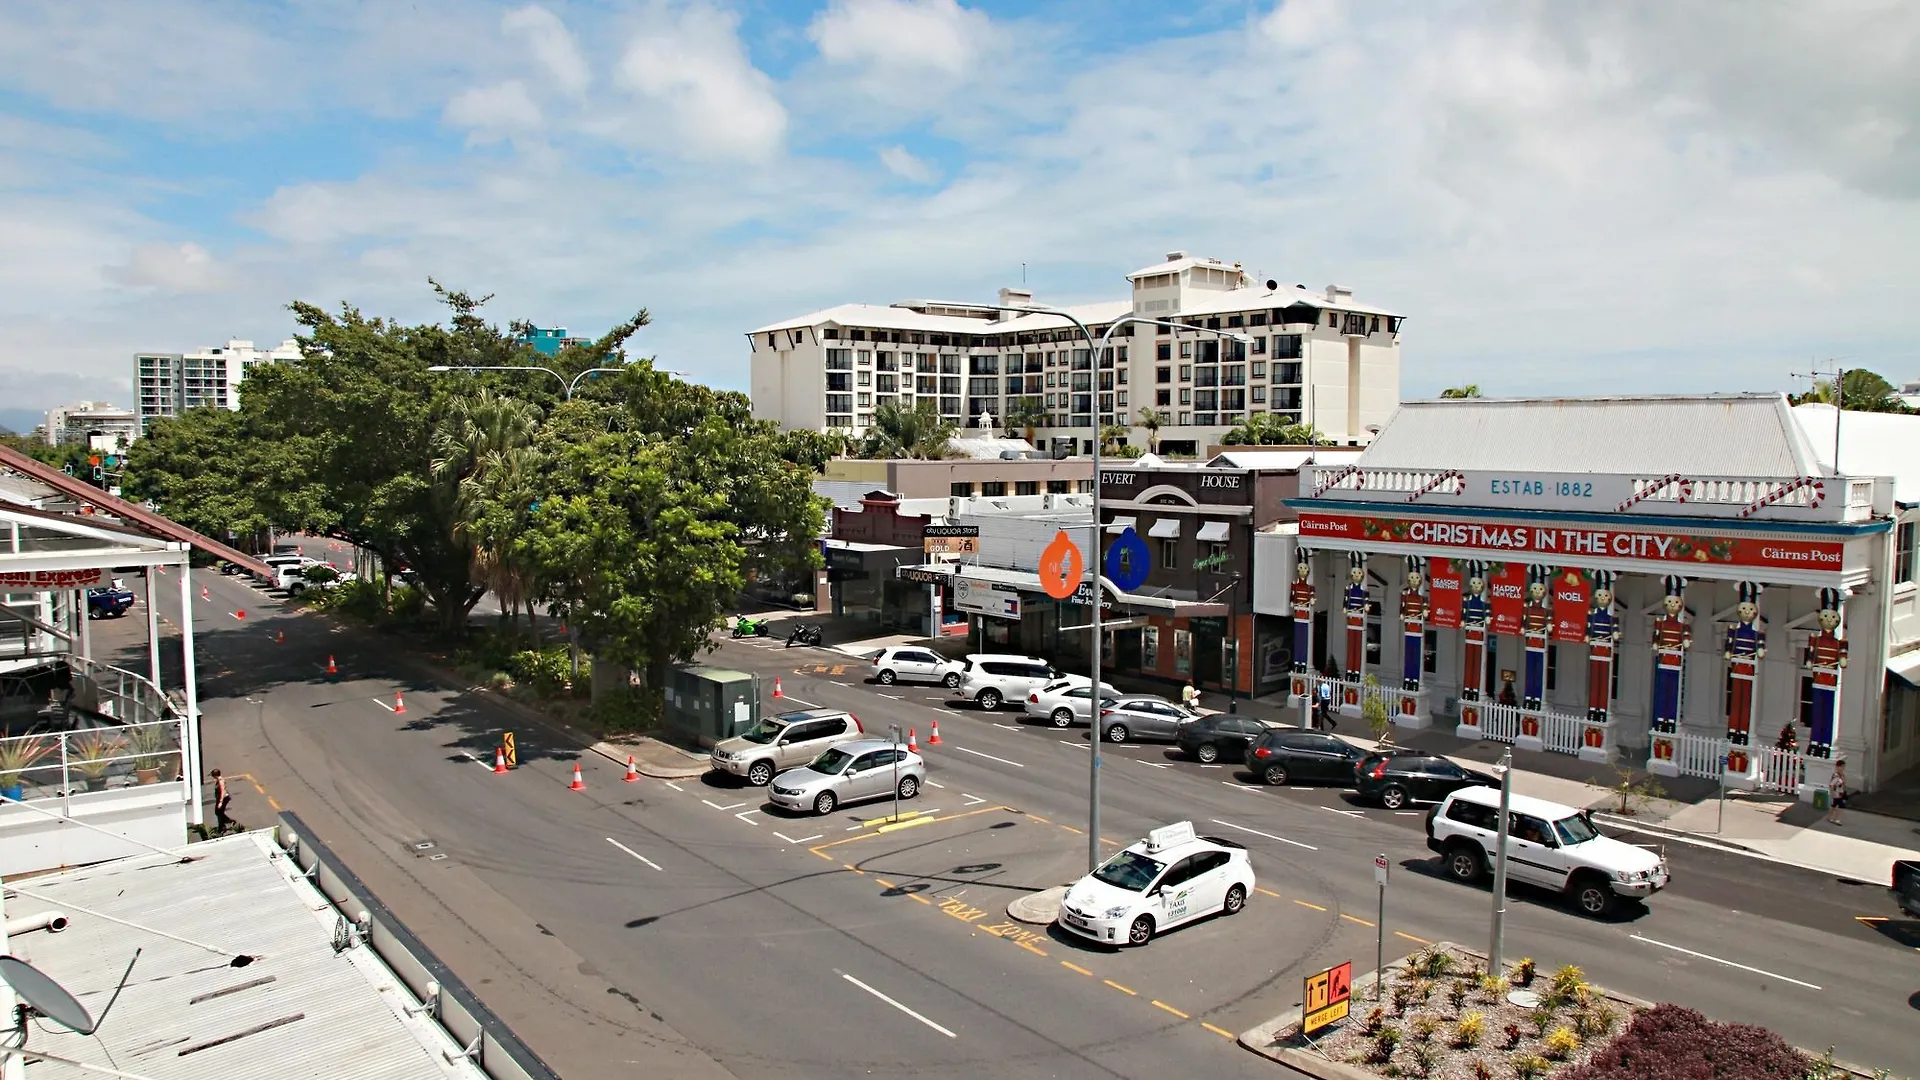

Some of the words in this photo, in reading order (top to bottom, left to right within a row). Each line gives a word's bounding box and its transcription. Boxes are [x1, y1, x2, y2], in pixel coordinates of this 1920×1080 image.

[1101, 472, 1136, 485] EVERT
[1200, 475, 1240, 488] HOUSE
[1491, 480, 1543, 495] ESTAB
[1556, 482, 1592, 497] 1882
[937, 527, 961, 536] LIQUOR
[1300, 519, 1329, 530] Cairns
[1330, 522, 1348, 531] Post
[958, 538, 973, 551] 酒
[1410, 522, 1528, 548] CHRISTMAS
[1535, 529, 1556, 550] IN
[1561, 531, 1607, 554] THE
[1612, 533, 1673, 557] CITY
[930, 544, 950, 552] GOLD
[1761, 547, 1808, 561] Cairns
[1810, 549, 1841, 563] Post
[36, 568, 101, 584] Express
[911, 570, 932, 583] LIQUOR
[1493, 584, 1522, 594] HAPPY
[1071, 595, 1084, 604] Fine
[1558, 592, 1584, 602] NOEL
[938, 897, 988, 920] TAXI
[990, 921, 1048, 946] ZONE
[1310, 1012, 1328, 1025] MERGE
[1330, 1005, 1343, 1018] LEFT
